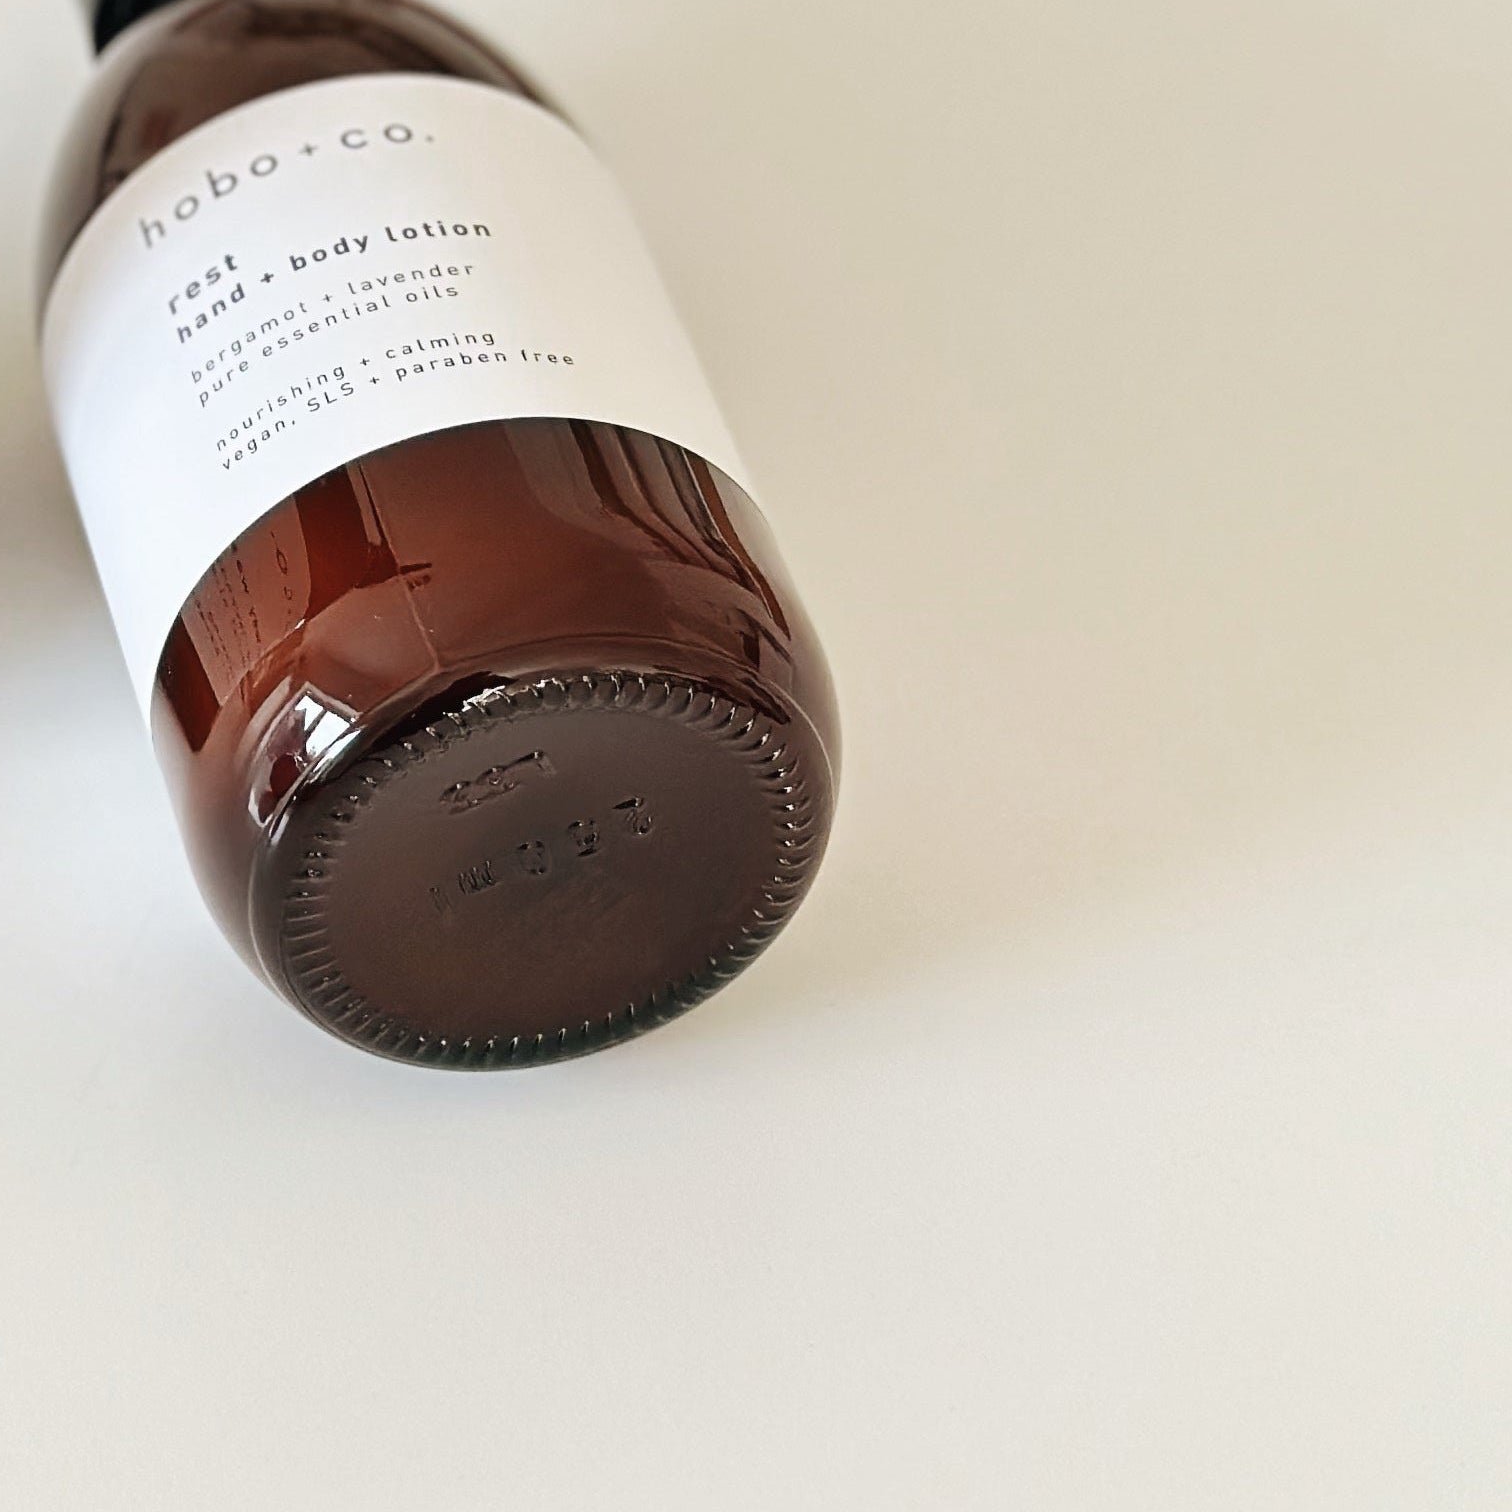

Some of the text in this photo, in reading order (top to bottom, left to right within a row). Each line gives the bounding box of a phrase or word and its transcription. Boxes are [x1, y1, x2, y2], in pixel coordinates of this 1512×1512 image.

[138, 122, 435, 249] hobo + co.
[168, 253, 238, 316] rest
[176, 220, 492, 344] hand + body lotion
[191, 263, 474, 385] bergamot + lavender
[198, 285, 459, 409] pure essential oils
[216, 332, 496, 452] nourishing + calming
[222, 348, 576, 471] vegan, SLS + paraben free
